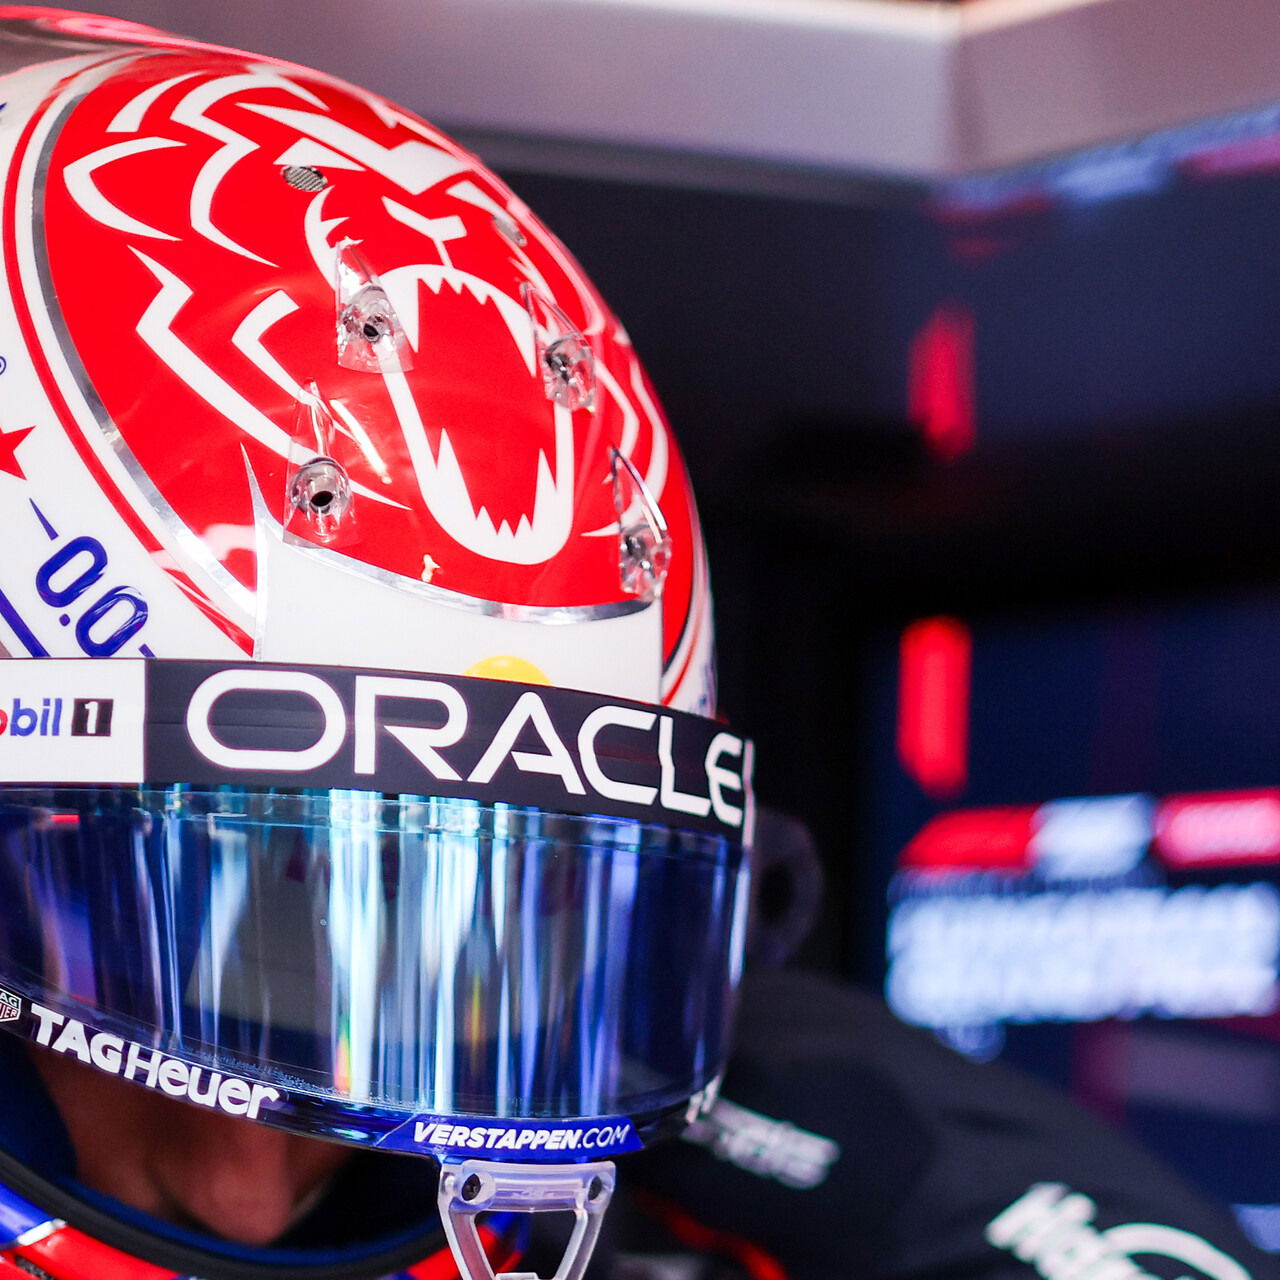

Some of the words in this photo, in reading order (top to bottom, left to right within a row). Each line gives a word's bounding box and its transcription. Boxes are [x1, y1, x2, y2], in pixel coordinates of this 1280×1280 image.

[71, 698, 114, 737] 1
[186, 668, 742, 828] ORACLE
[413, 1121, 630, 1150] VERSTAPPEN.COM
